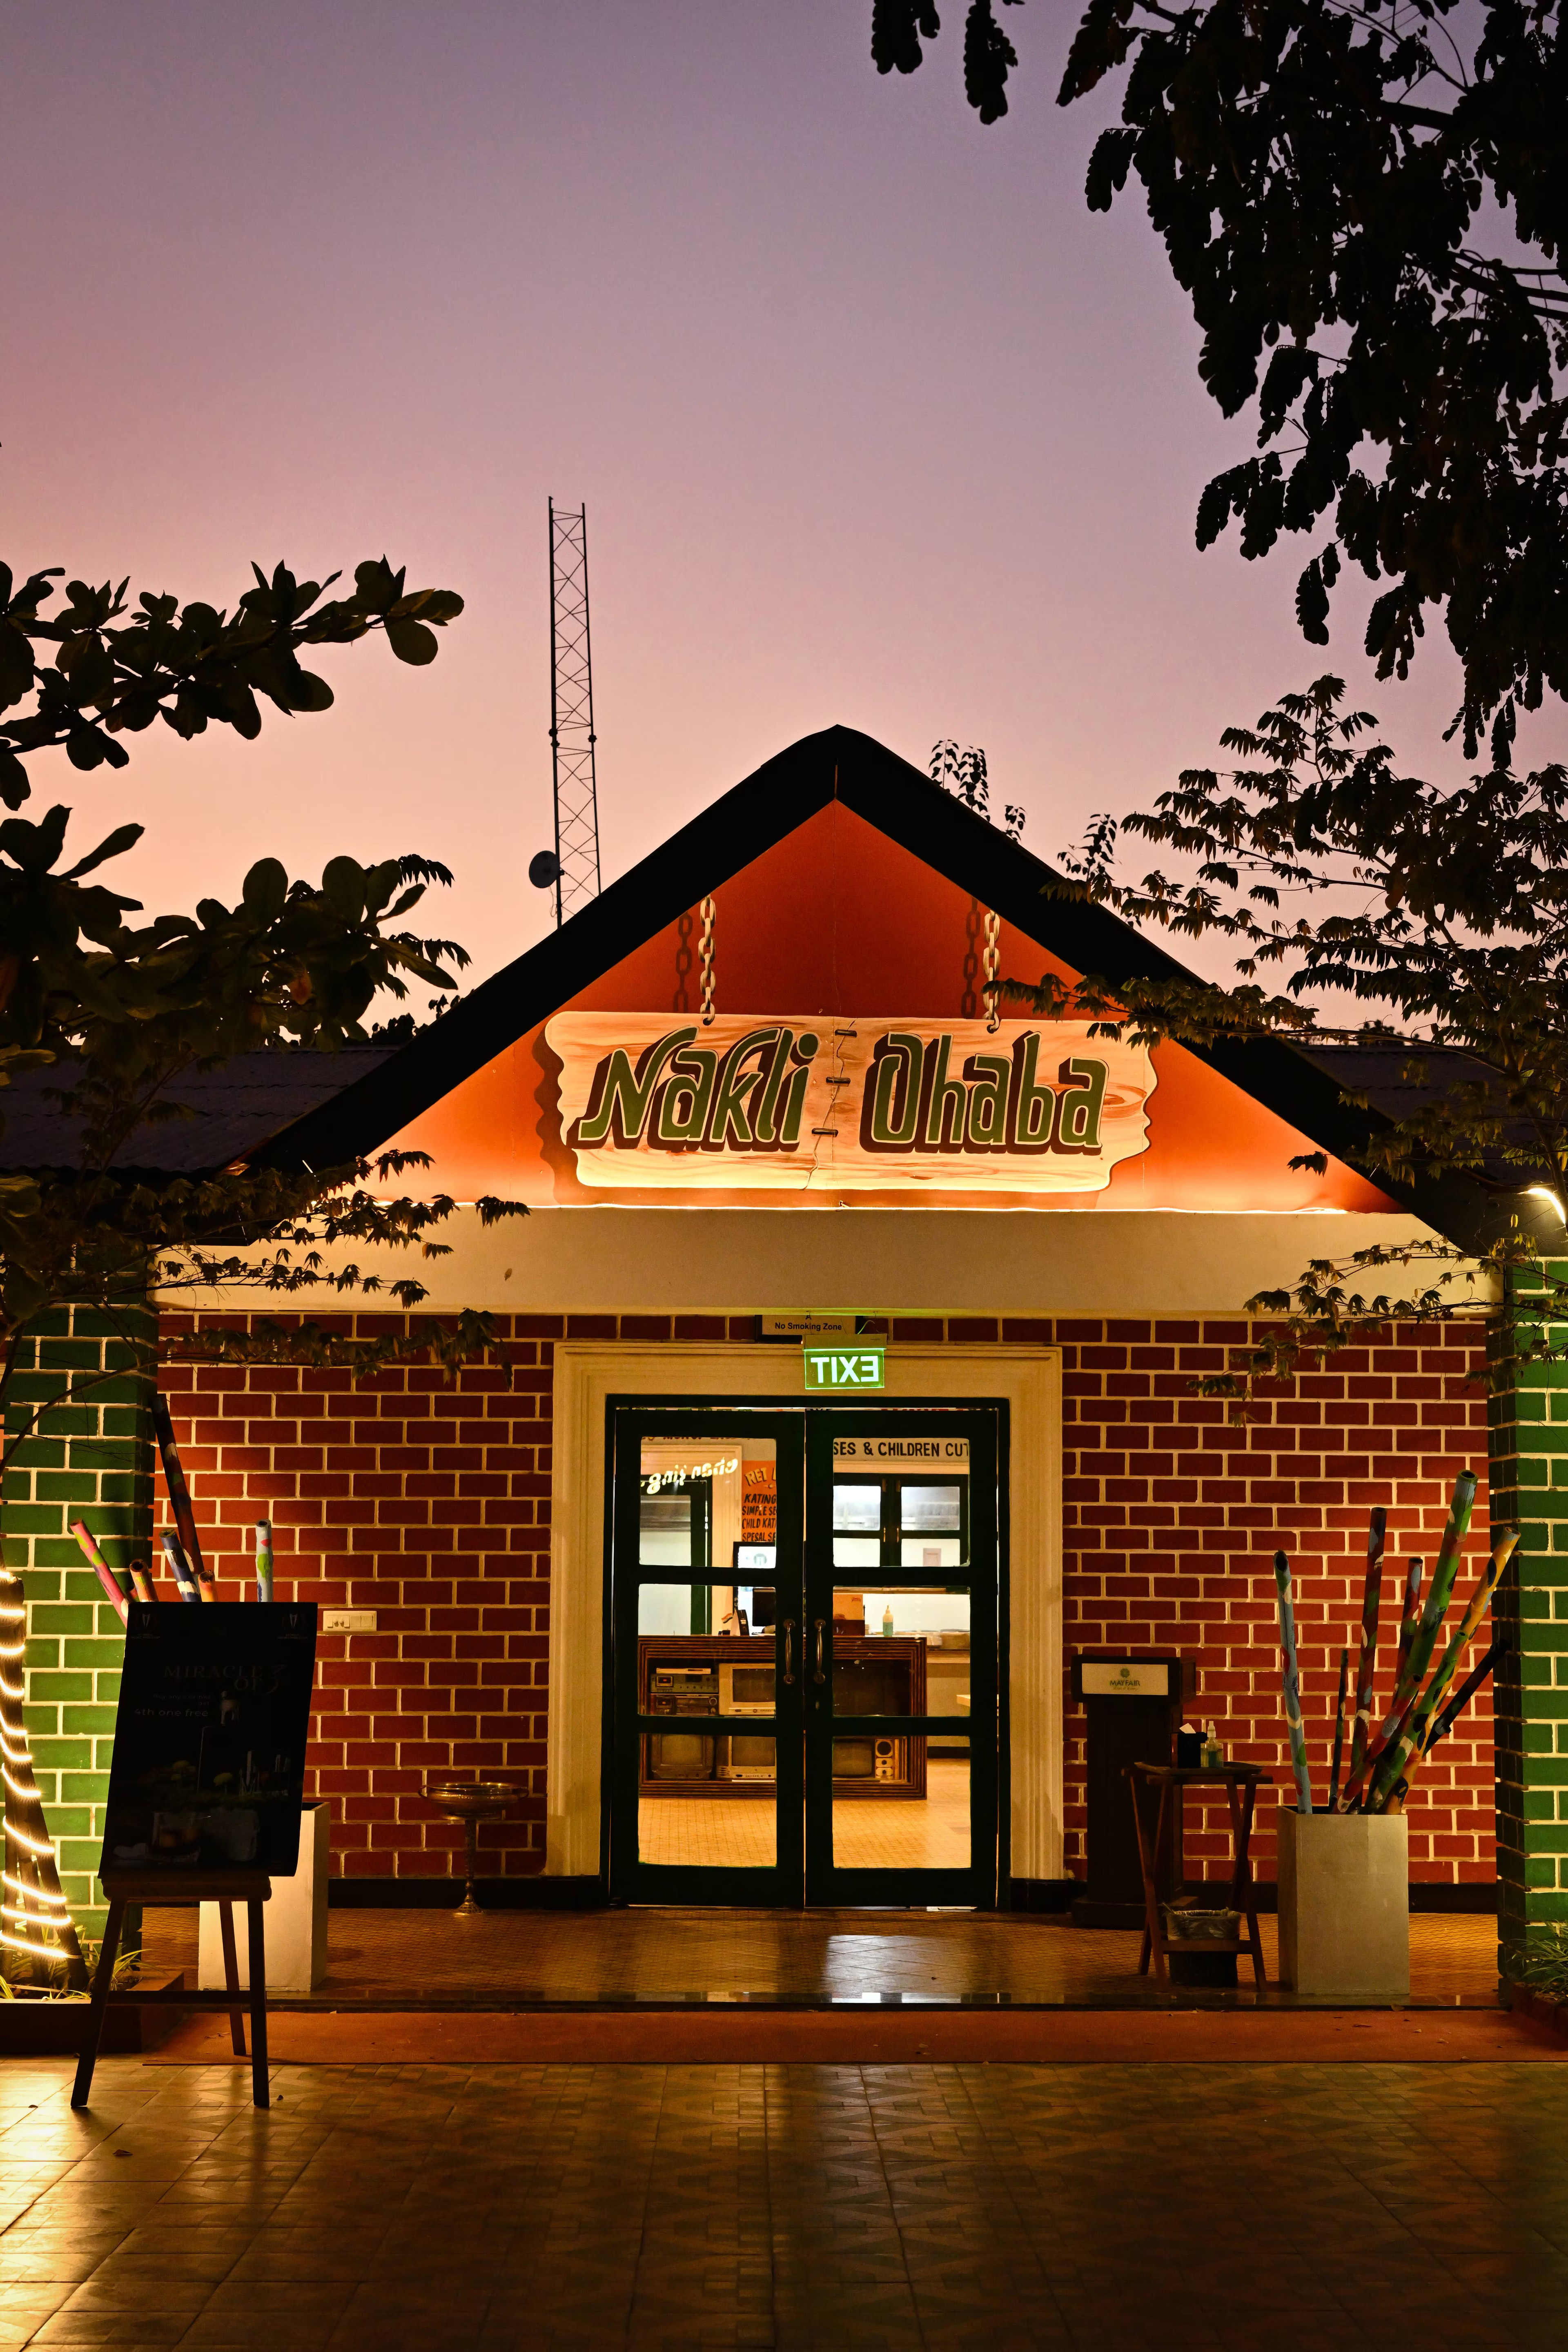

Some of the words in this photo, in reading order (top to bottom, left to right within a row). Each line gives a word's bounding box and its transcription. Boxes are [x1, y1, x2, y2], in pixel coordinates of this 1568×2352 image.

[570, 1025, 820, 1151] Nakli
[860, 1030, 1110, 1154] Dhaba
[788, 1323, 821, 1331] Smoking
[864, 1441, 873, 1455] &
[878, 1442, 940, 1457] CHILDREN
[742, 1518, 760, 1529] CHILD
